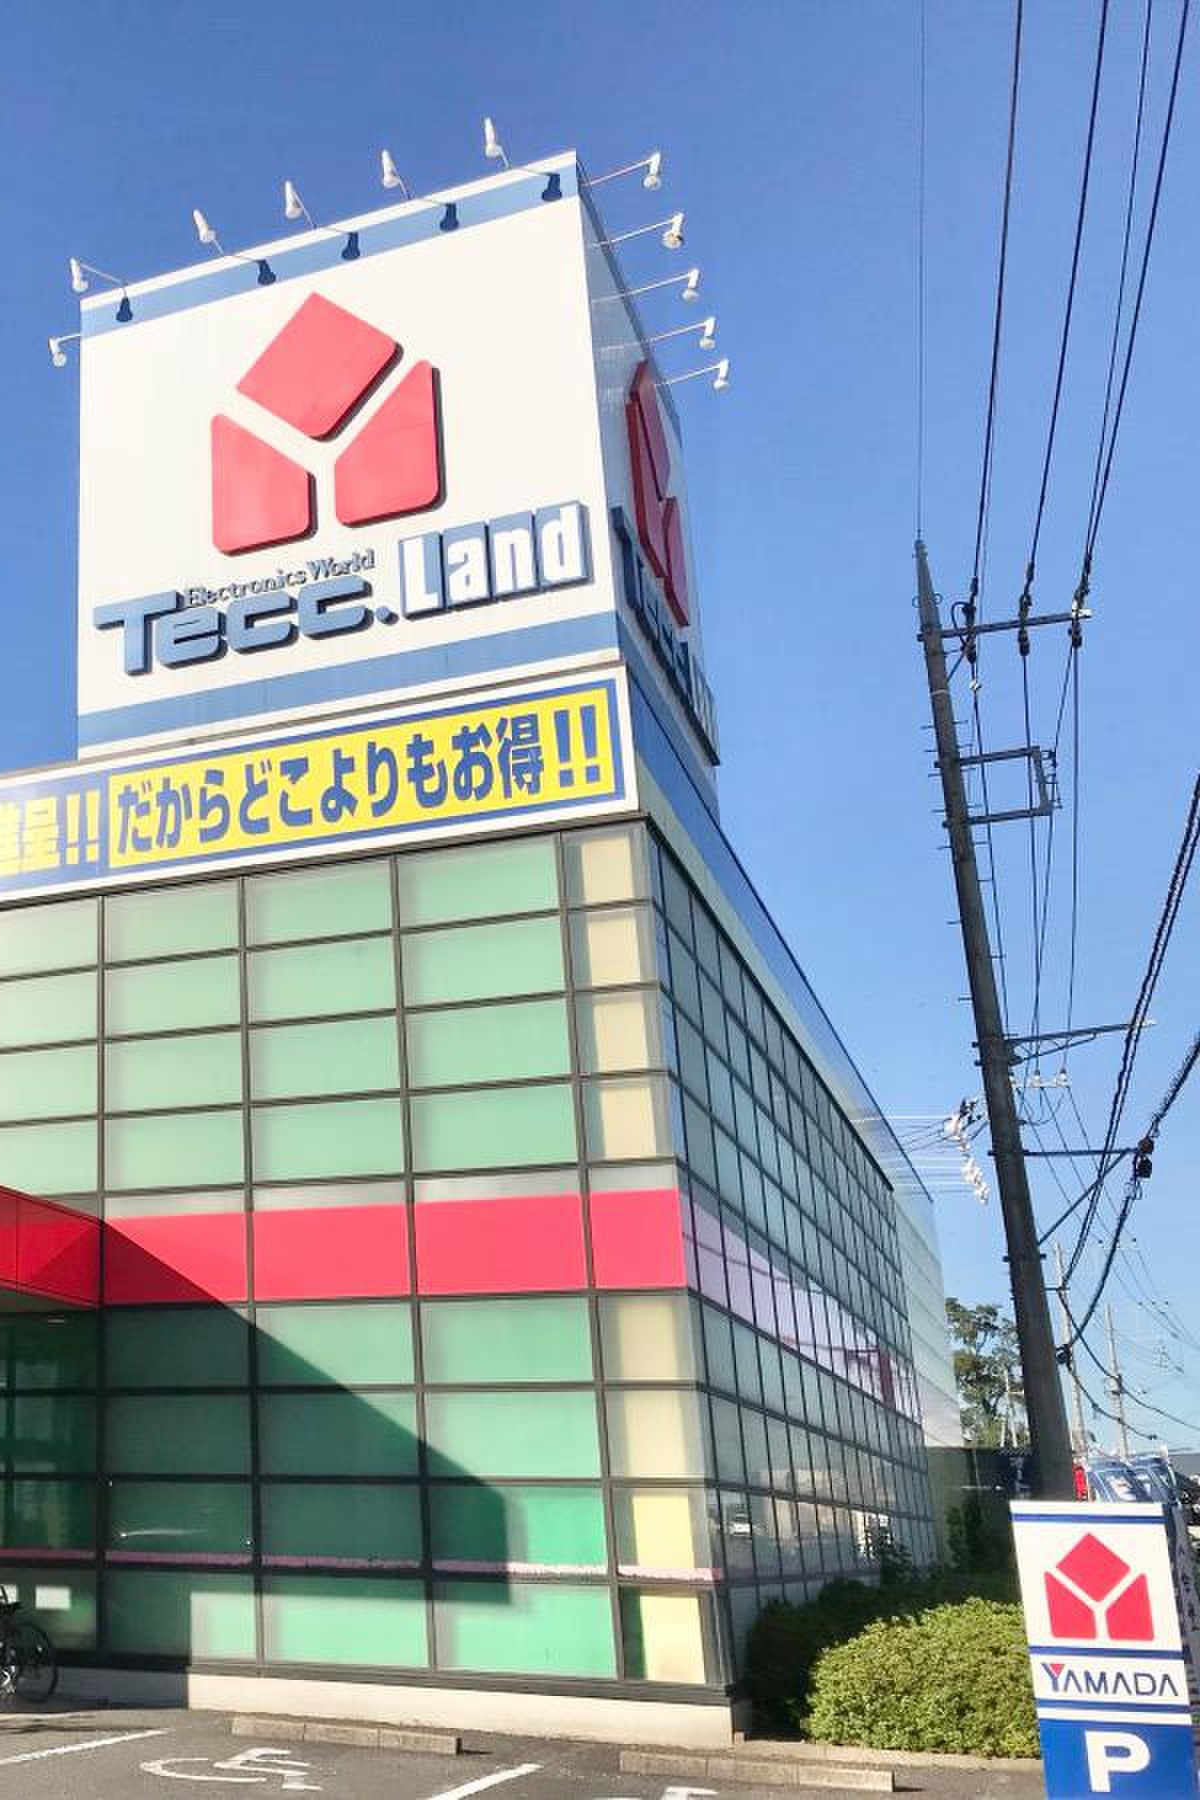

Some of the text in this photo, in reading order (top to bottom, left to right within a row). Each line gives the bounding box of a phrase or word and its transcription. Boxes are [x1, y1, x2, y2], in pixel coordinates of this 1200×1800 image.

[183, 547, 375, 609] Electronics World
[115, 704, 602, 856] だからどこよりもお得!!
[1041, 1662, 1179, 1698] YAMADA
[1085, 1730, 1151, 1793] P
